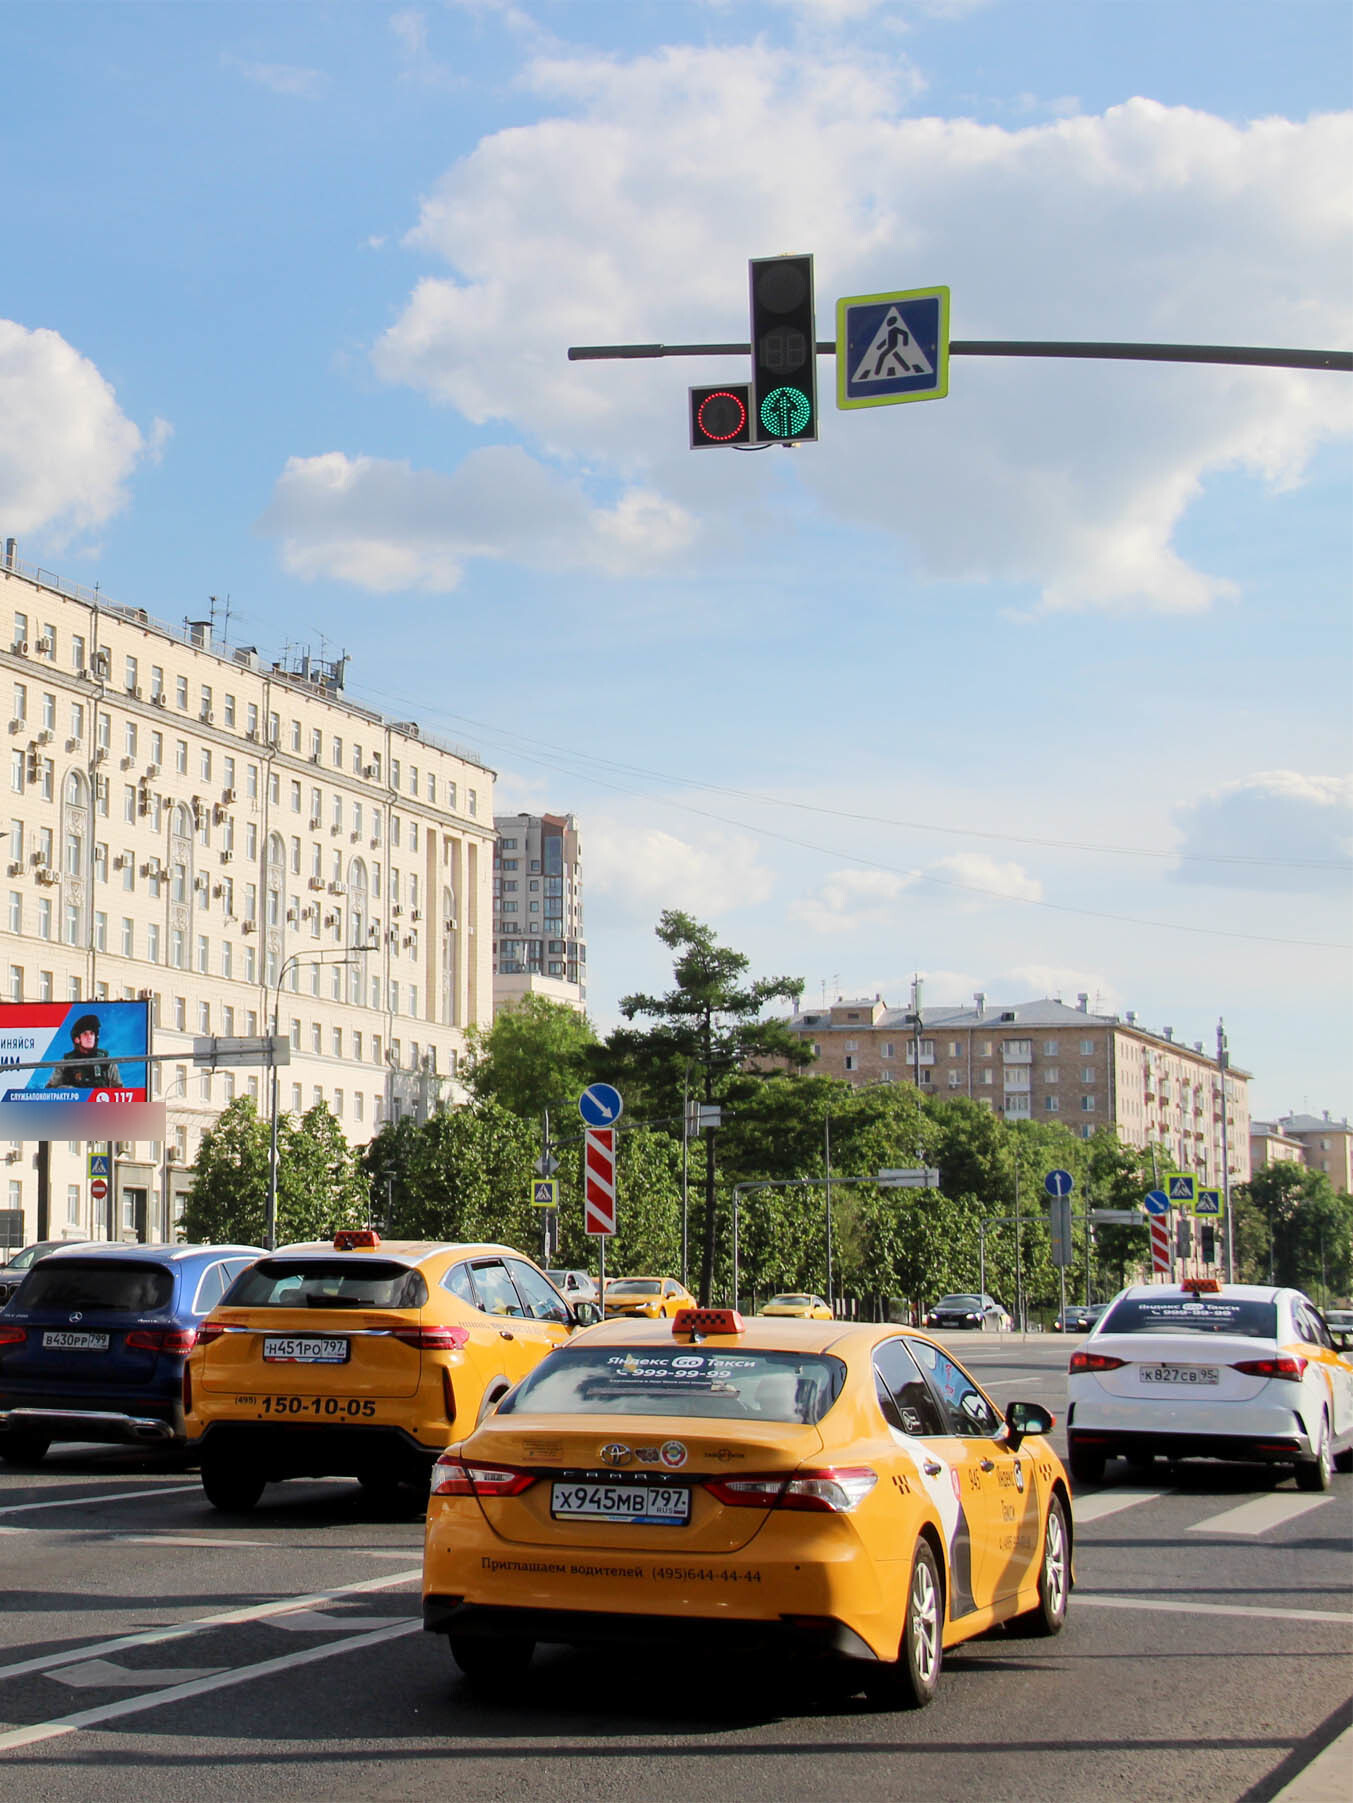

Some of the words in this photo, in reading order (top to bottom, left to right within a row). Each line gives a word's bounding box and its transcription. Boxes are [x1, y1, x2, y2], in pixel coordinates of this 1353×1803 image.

[10, 1092, 80, 1101] СЛУЖБАПОКОНТРАКТУ.РФ
[114, 1092, 133, 1102] 117
[269, 1341, 321, 1355] Н451РО
[323, 1341, 343, 1353] 797
[608, 1356, 669, 1366] Яндекс
[707, 1358, 756, 1368] Такси
[632, 1369, 731, 1378] 999-99-99
[262, 1396, 376, 1416] 150-10-05
[559, 1488, 645, 1511] Х945МВ
[650, 1489, 683, 1507] 797
[481, 1557, 566, 1574] Приглашаем
[570, 1564, 643, 1578] водителей
[651, 1567, 762, 1582] (495)644-44-44
